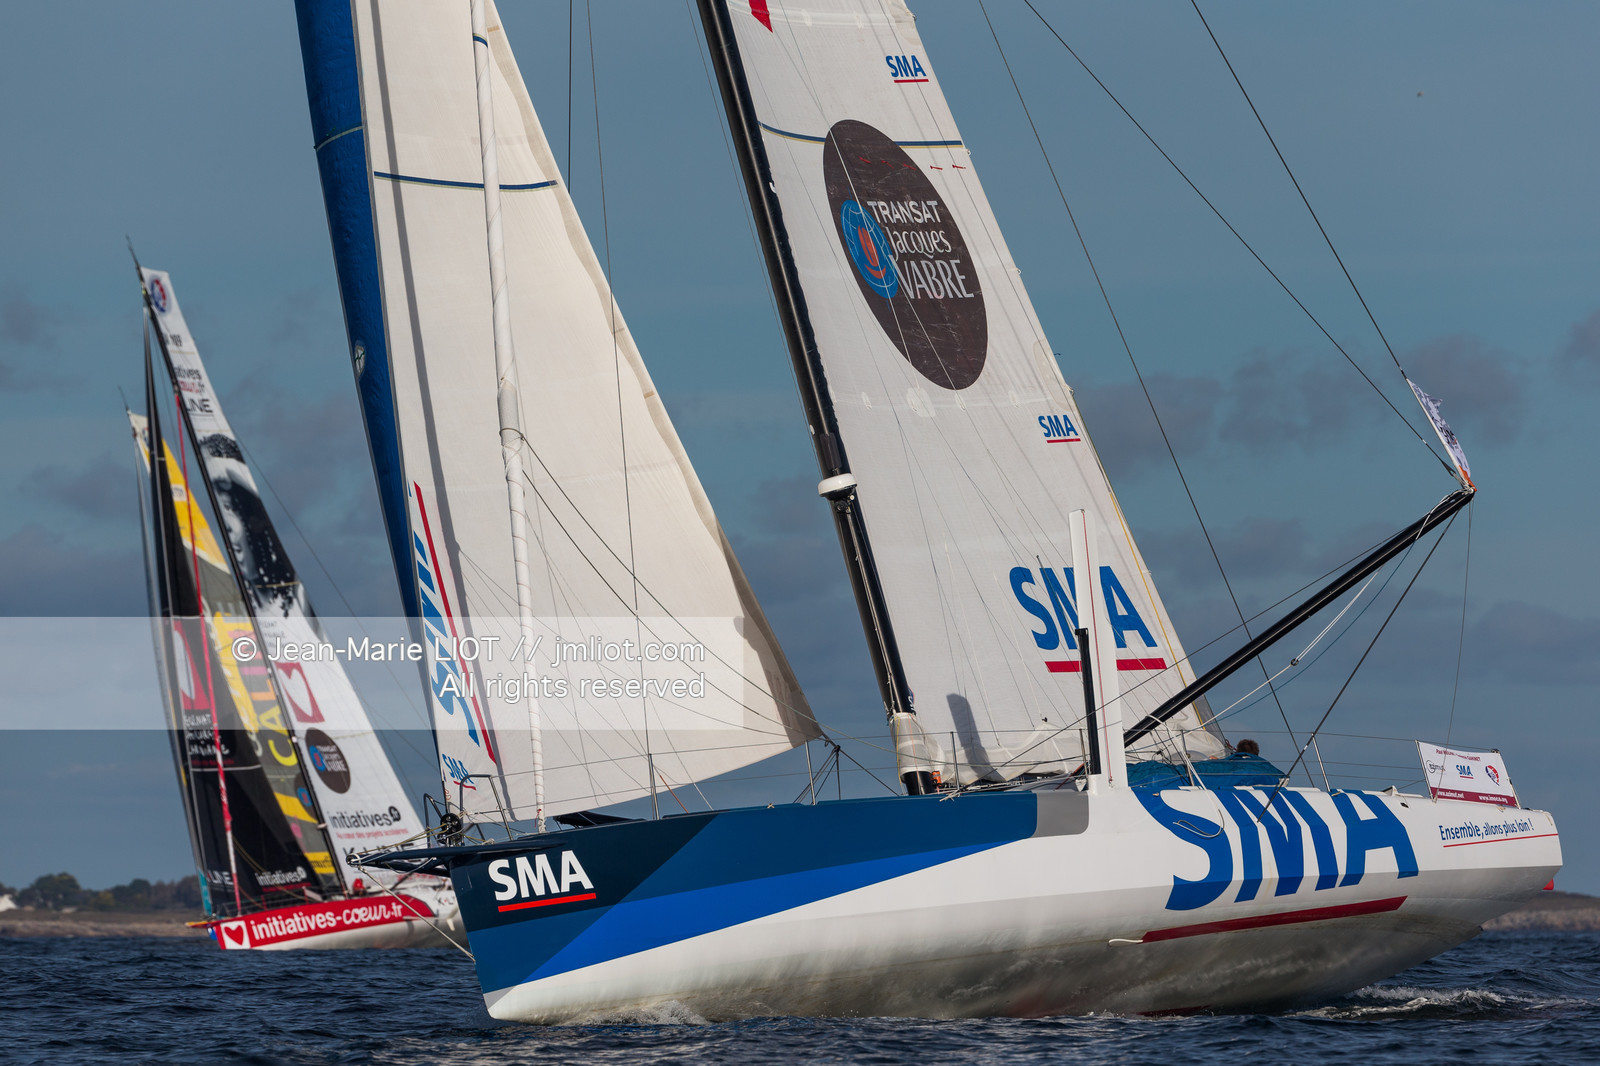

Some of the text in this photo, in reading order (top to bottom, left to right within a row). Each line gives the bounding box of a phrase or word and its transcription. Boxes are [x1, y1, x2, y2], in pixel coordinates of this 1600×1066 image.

[885, 55, 927, 78] SMA
[866, 200, 942, 224] TRANSAT
[887, 254, 975, 300] VABRE
[1037, 414, 1079, 438] SMA
[1456, 764, 1473, 777] SMA
[1438, 821, 1484, 841] Ensemble,
[1483, 822, 1504, 837] allons
[1502, 820, 1518, 837] plus
[1515, 819, 1530, 833] loin
[1131, 785, 1419, 911] SMA
[487, 850, 594, 901] SMA
